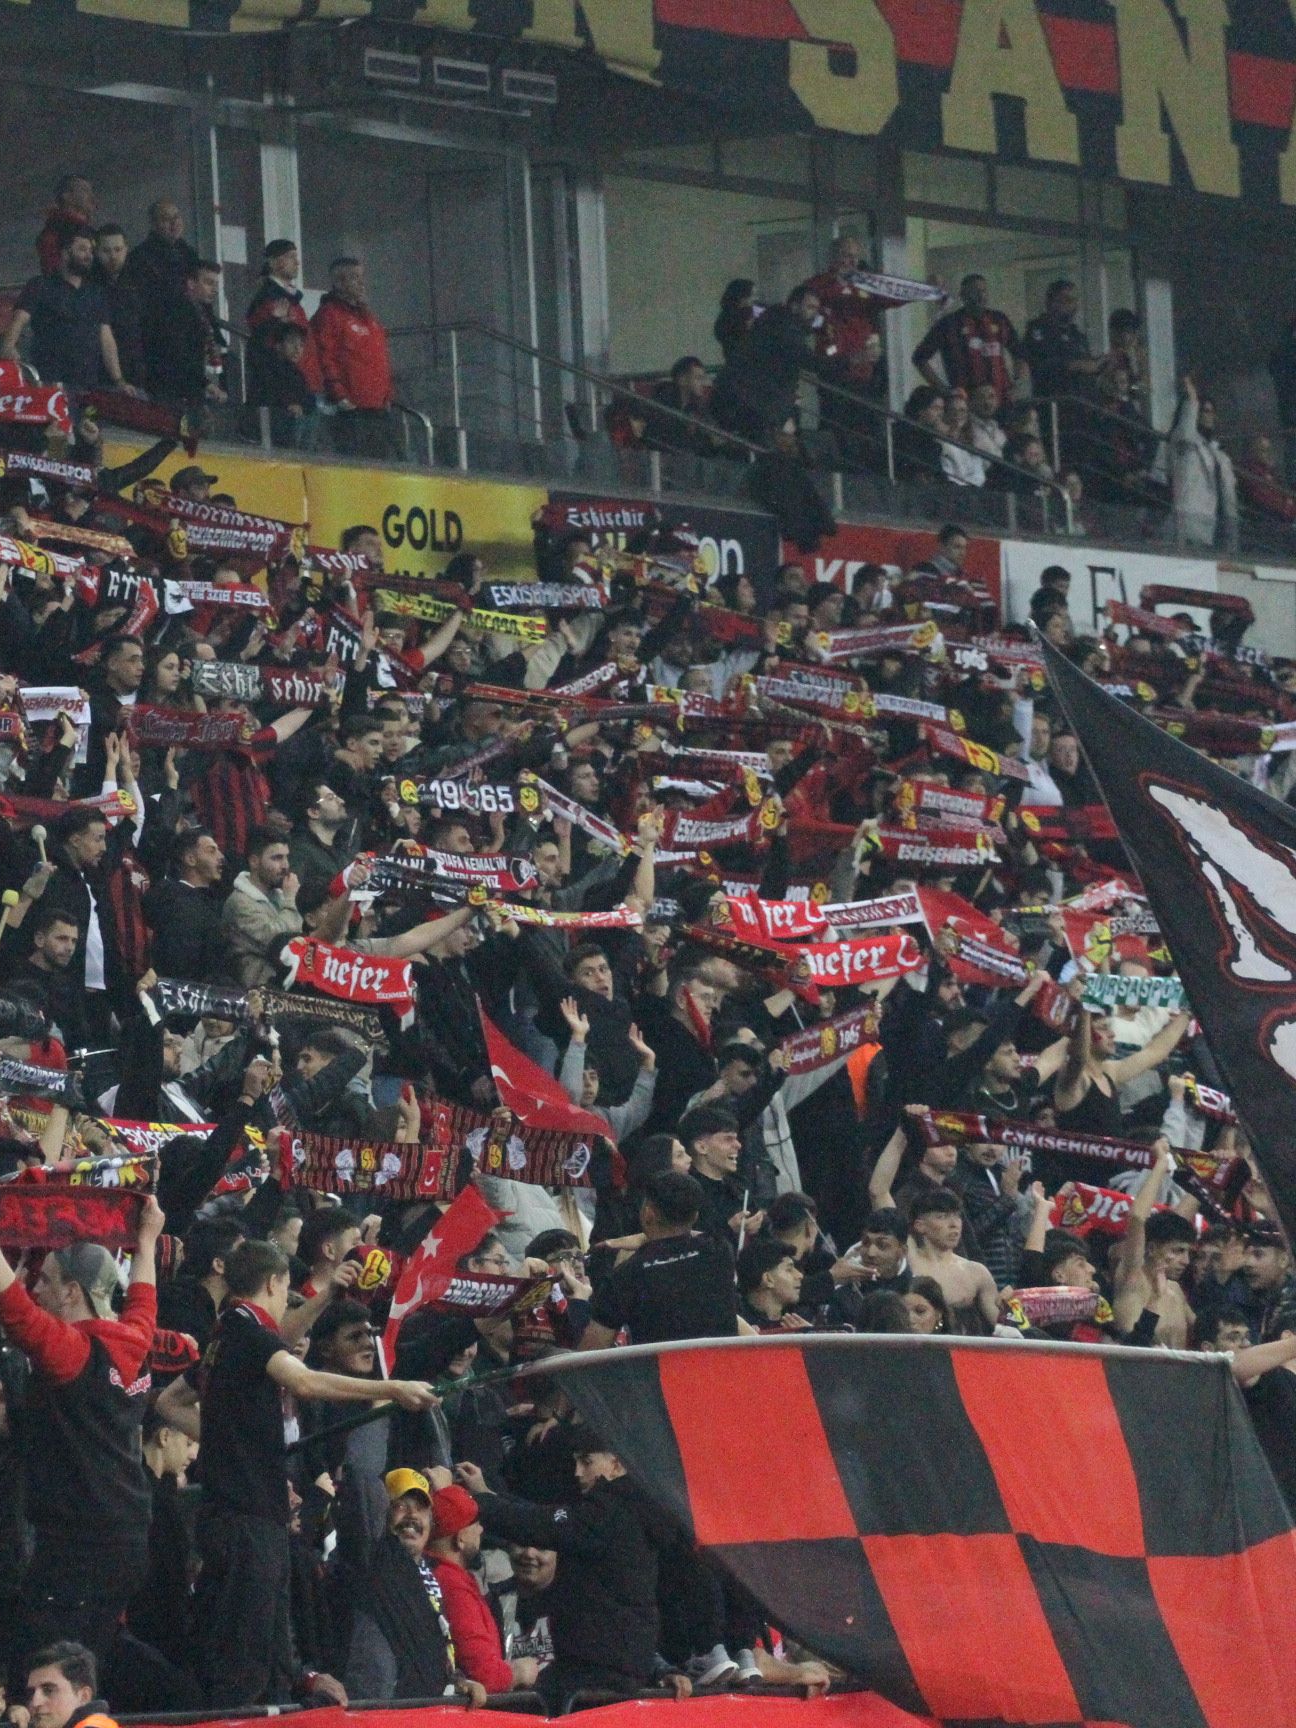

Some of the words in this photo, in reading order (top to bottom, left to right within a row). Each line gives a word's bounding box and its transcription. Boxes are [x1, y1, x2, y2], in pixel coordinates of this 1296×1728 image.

[382, 504, 464, 552] GOLD
[738, 899, 796, 938] nfer
[322, 956, 390, 994] nefer
[799, 942, 887, 983] nefer
